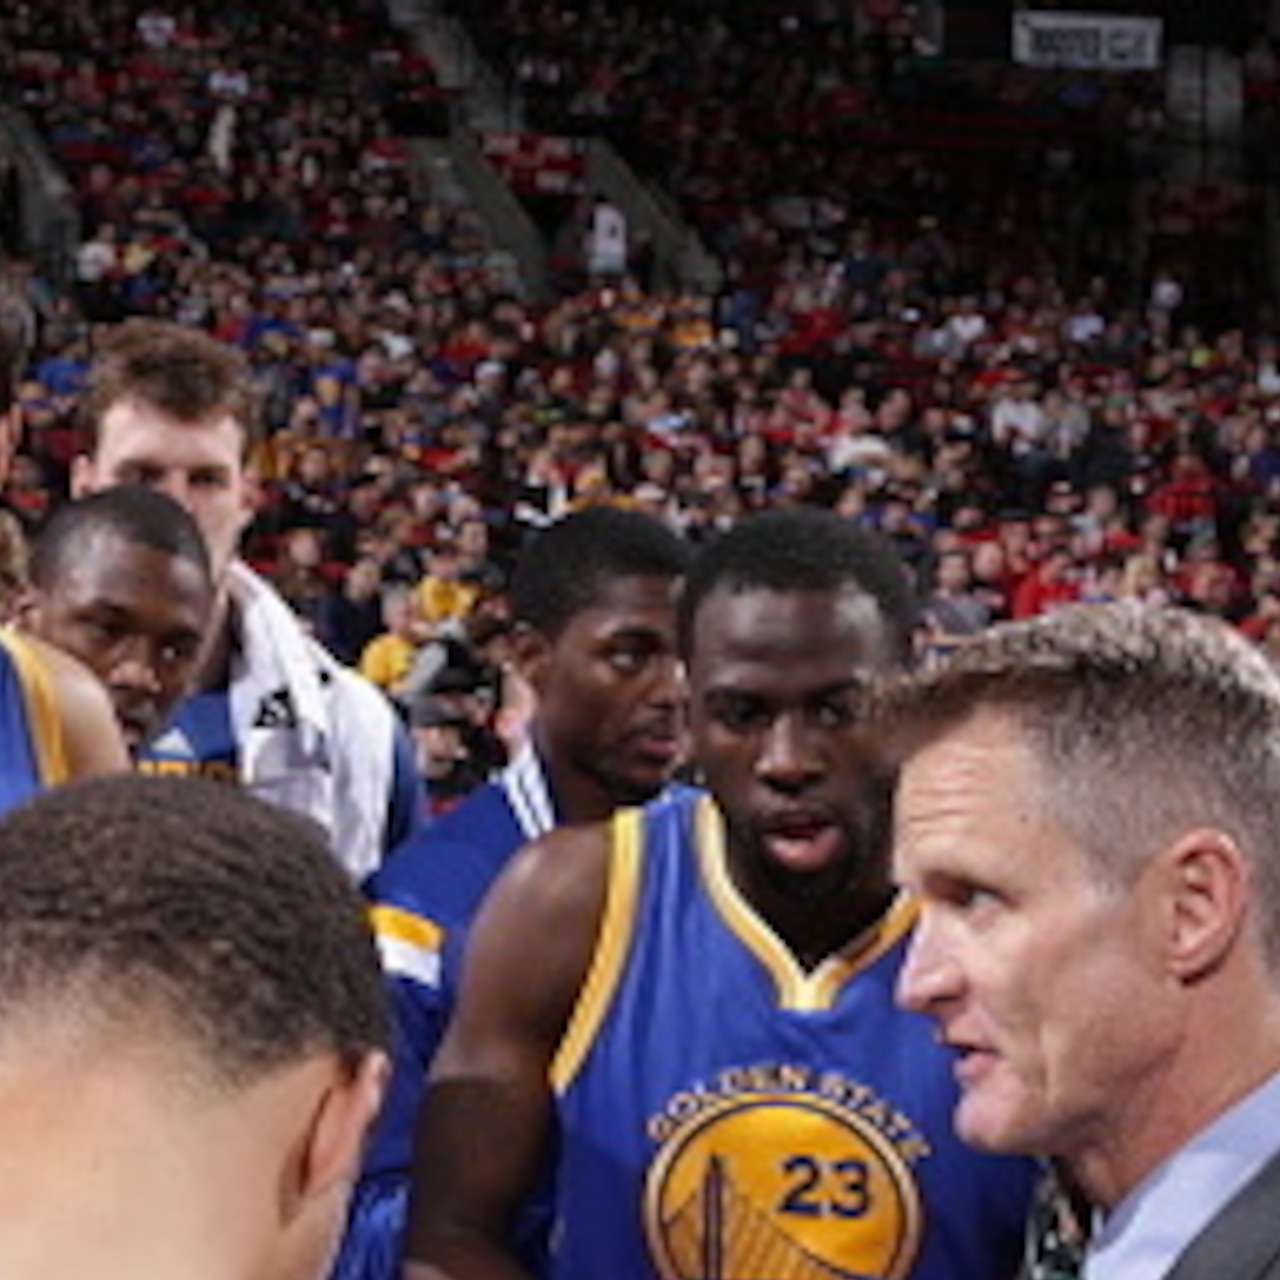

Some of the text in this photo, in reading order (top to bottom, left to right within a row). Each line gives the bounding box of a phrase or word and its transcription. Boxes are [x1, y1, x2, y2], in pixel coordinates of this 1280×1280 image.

[646, 1064, 933, 1158] GOLDEN STATE
[777, 1155, 872, 1219] 23
